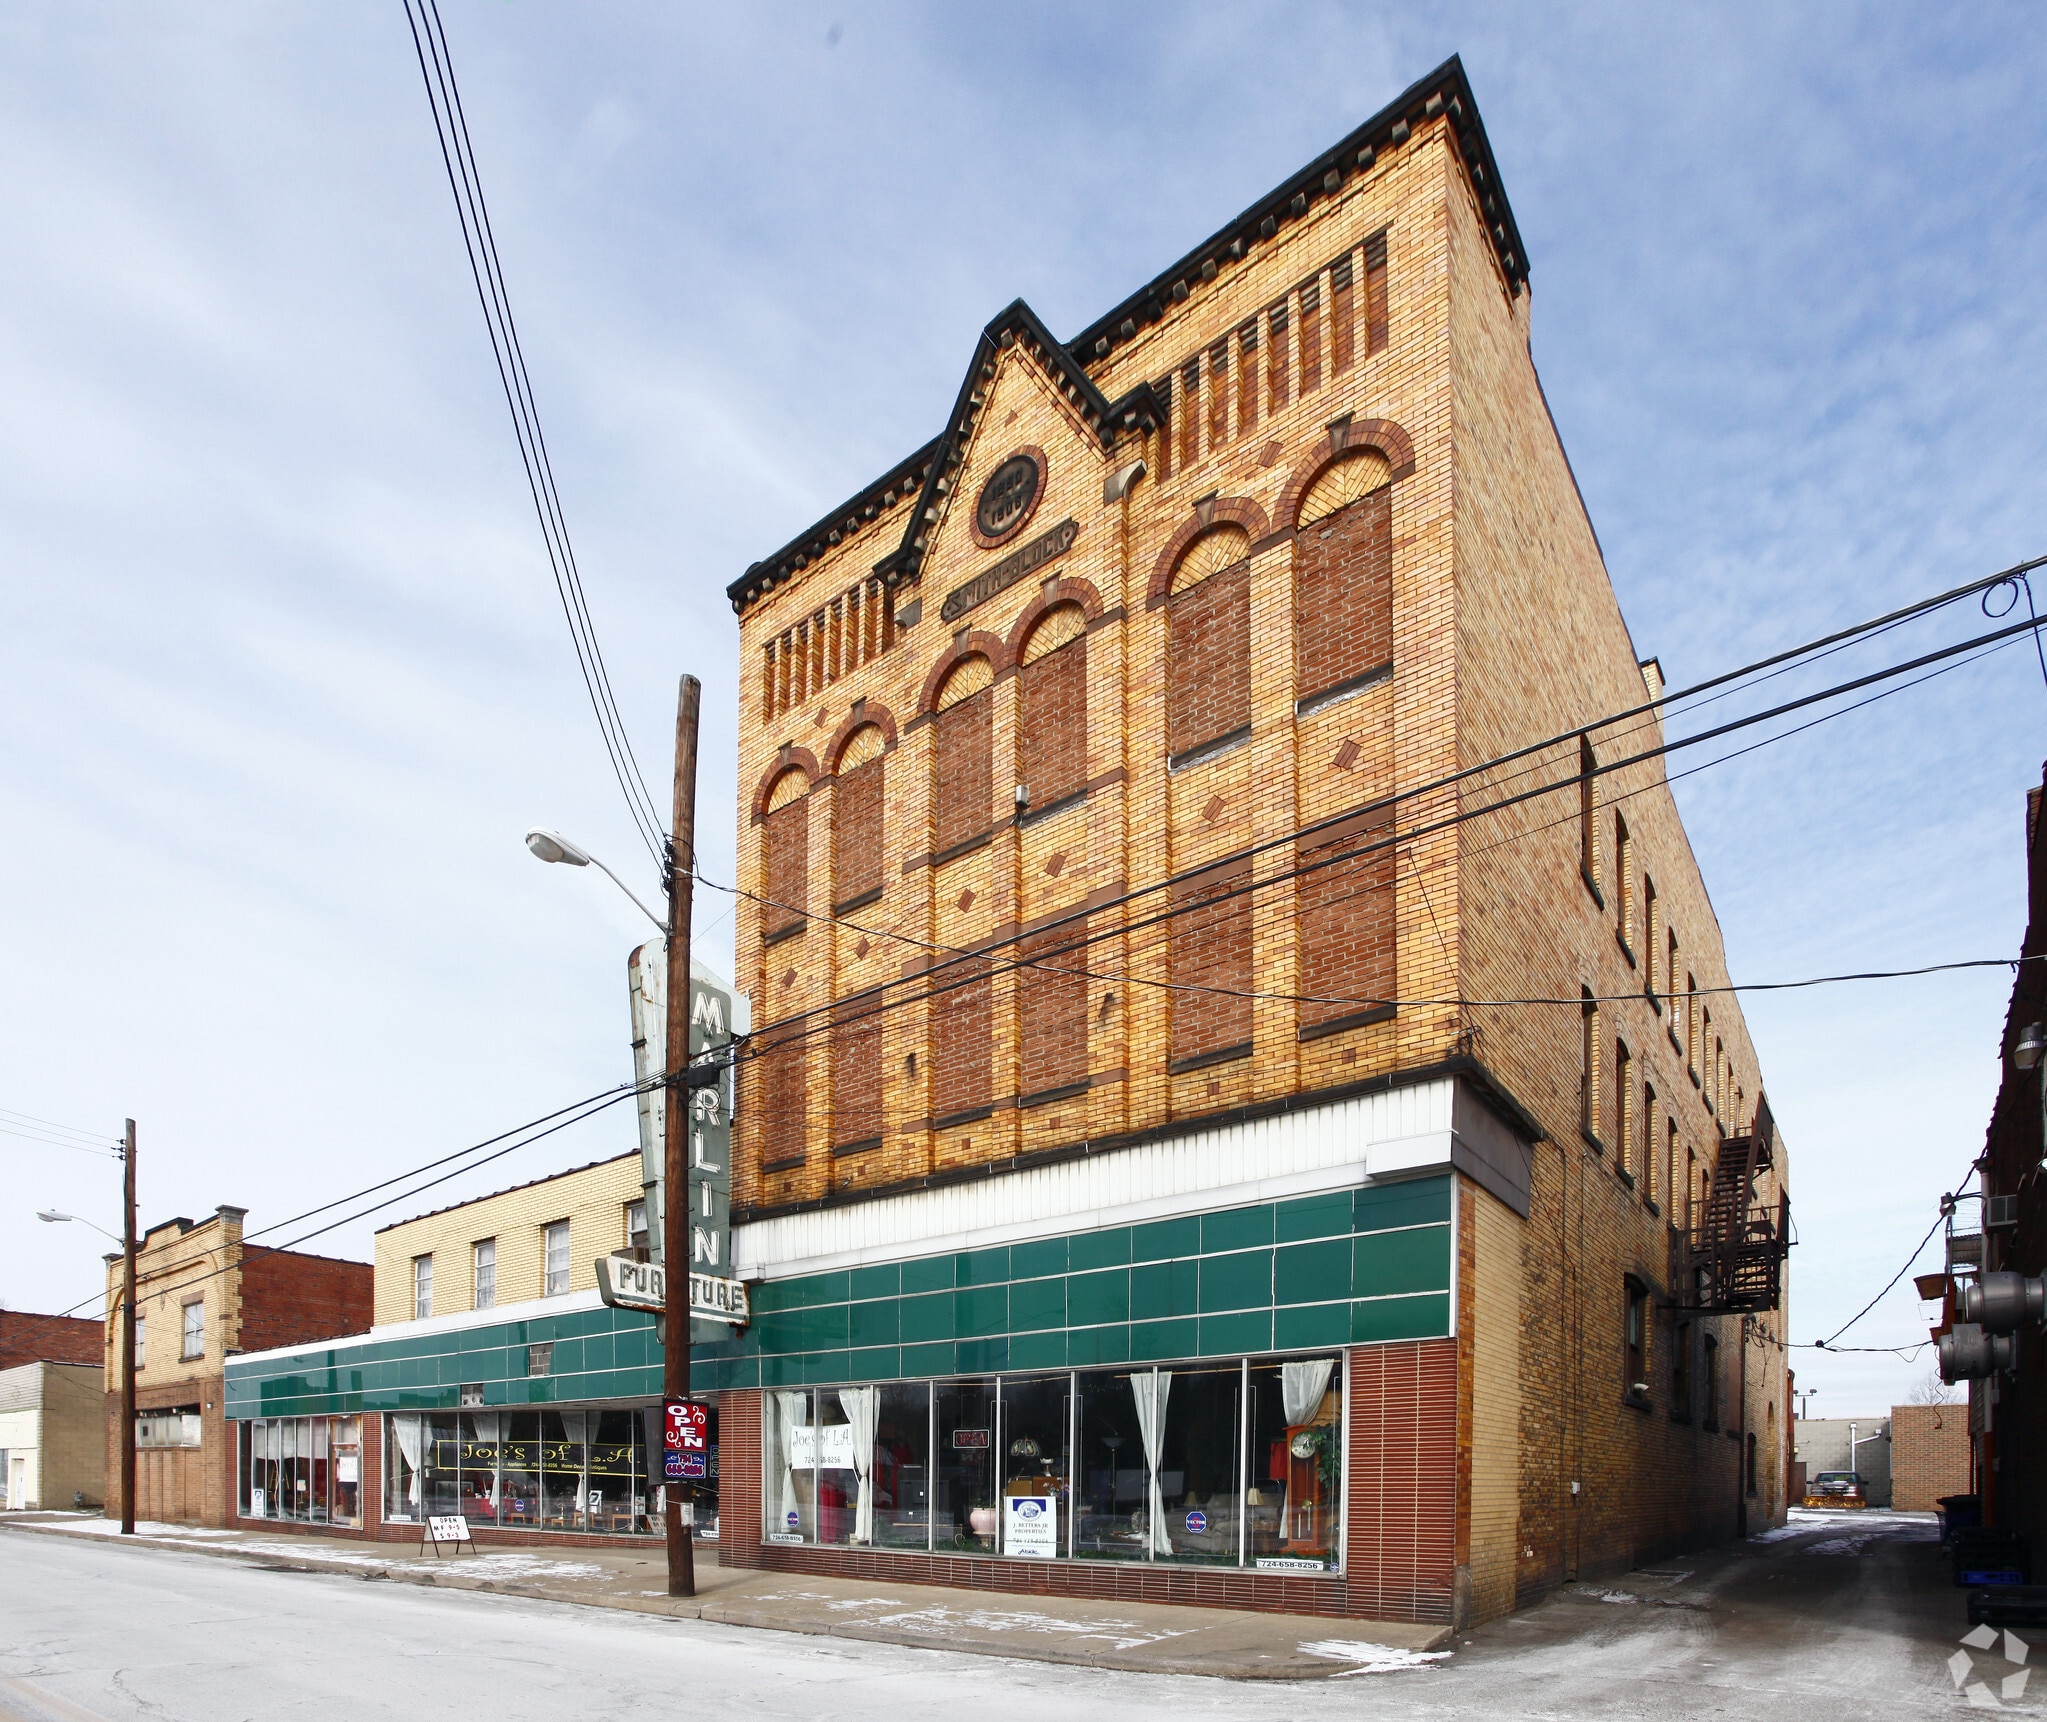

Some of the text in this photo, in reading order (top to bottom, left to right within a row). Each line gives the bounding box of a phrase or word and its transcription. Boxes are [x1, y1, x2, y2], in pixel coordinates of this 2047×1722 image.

[619, 1262, 746, 1312] FURTURE
[667, 1405, 703, 1448] OPEN
[955, 1431, 988, 1447] OPEN
[460, 1443, 526, 1460] Joe's
[1261, 1560, 1319, 1569] 724-658-8256
